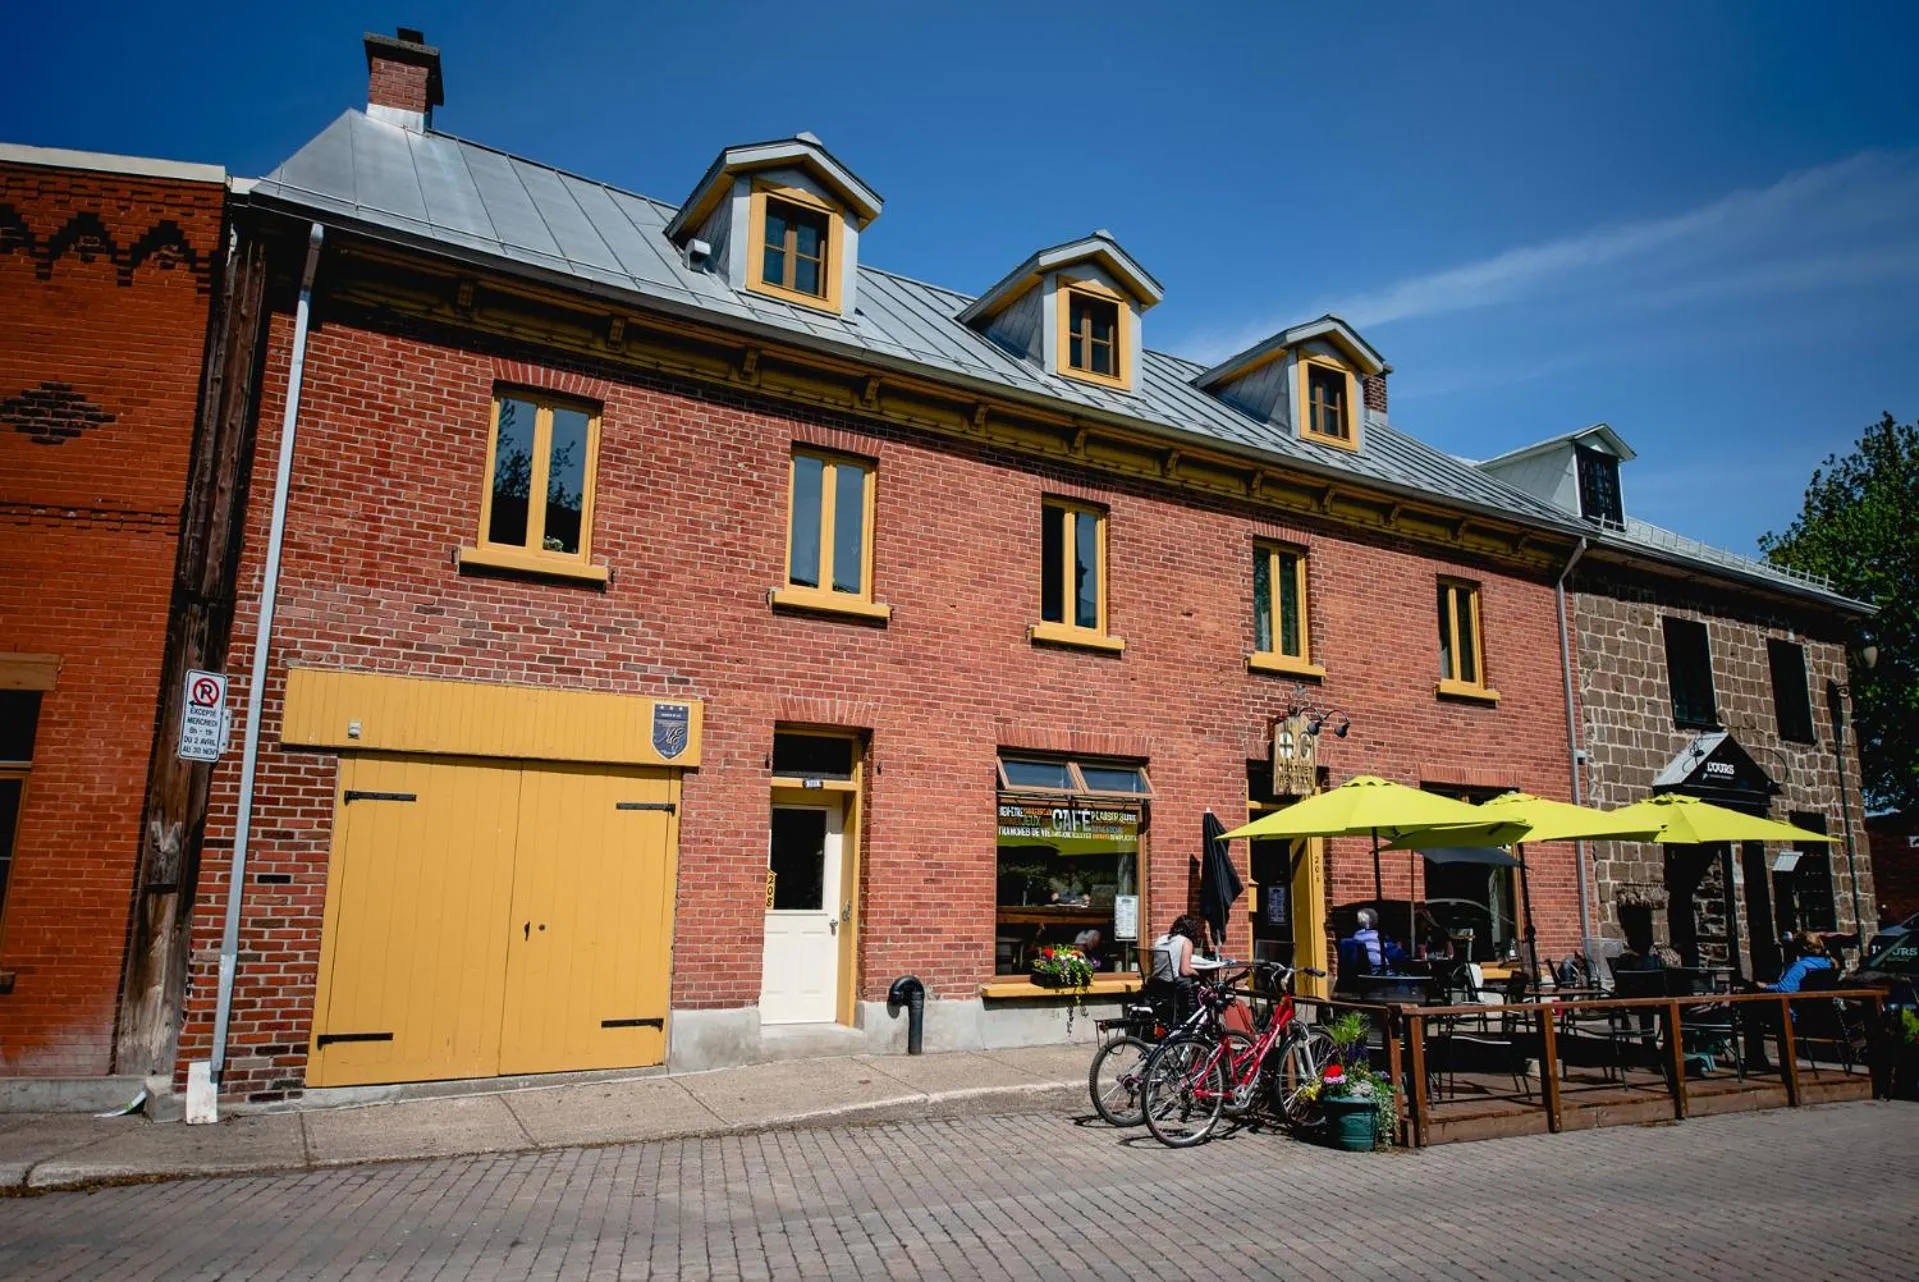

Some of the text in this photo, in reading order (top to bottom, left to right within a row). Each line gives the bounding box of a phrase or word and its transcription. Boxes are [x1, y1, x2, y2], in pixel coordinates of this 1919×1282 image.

[187, 717, 218, 728] MERCREDI
[183, 735, 193, 744] DU
[200, 737, 216, 747] AVRIL
[182, 744, 191, 753] AU
[1052, 807, 1092, 833] CAFÉ
[765, 875, 775, 907] 208
